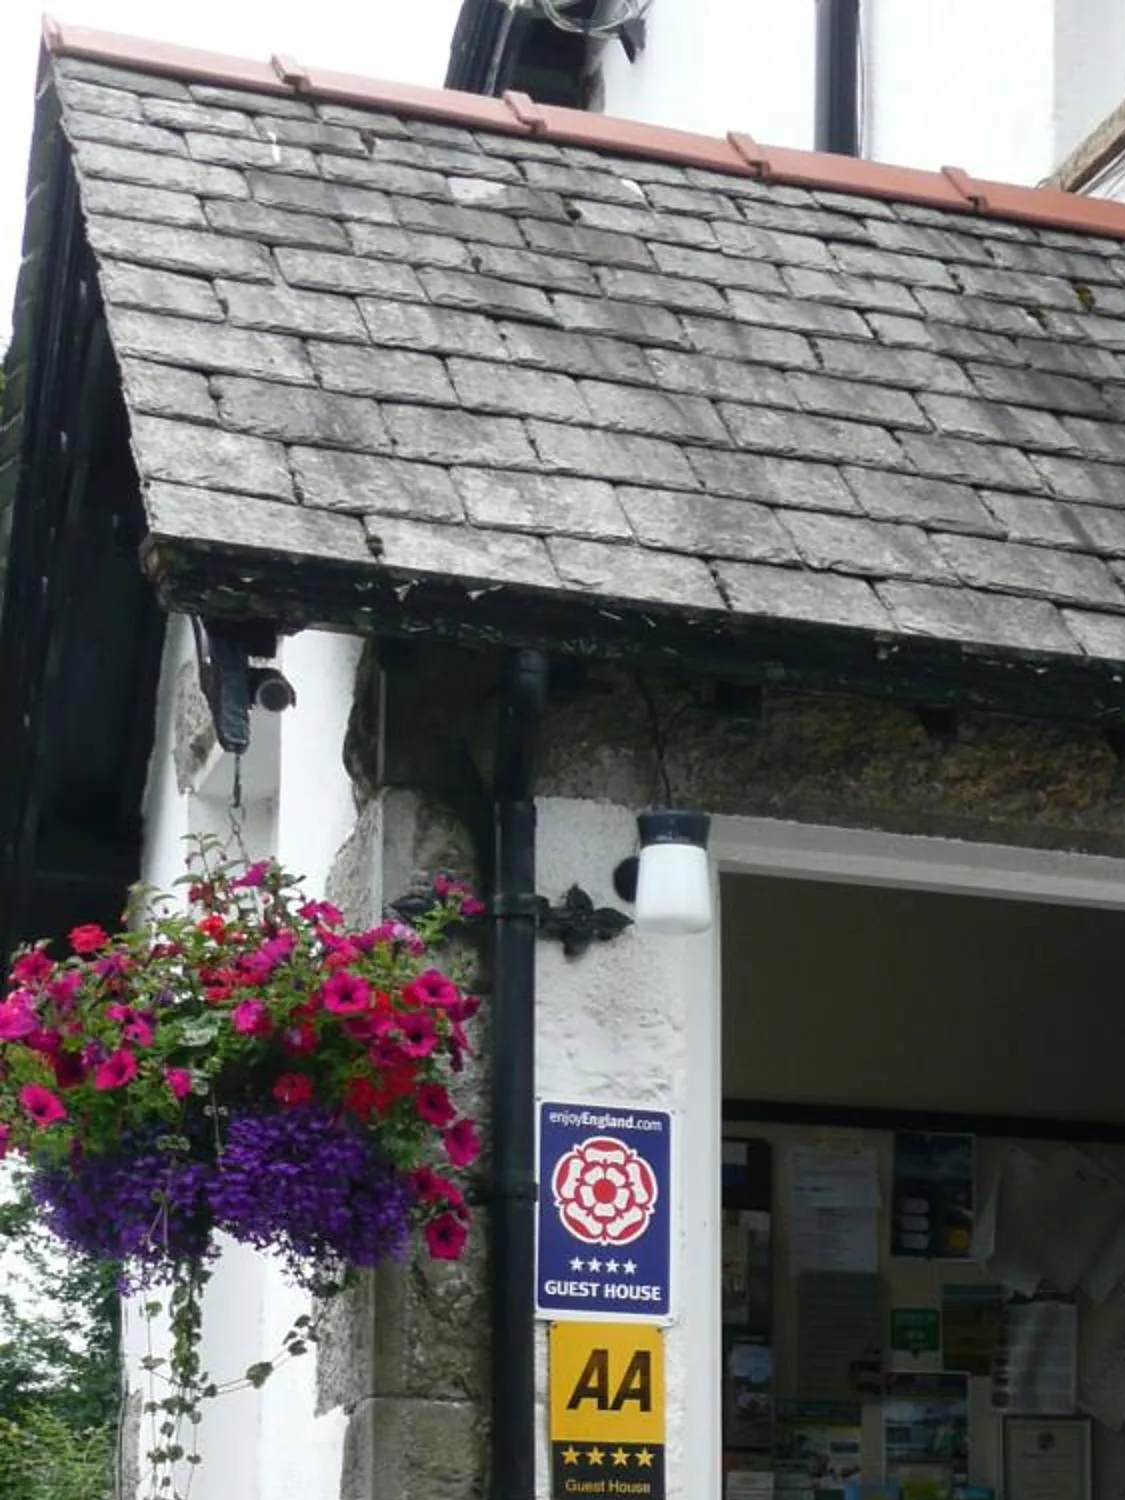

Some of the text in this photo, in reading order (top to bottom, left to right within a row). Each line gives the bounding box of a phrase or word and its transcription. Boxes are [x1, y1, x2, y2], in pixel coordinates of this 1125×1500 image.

[549, 1110, 663, 1131] enjoyEngland.com
[544, 1280, 662, 1301] GUEST HOUSE
[565, 1348, 652, 1412] AA
[565, 1478, 651, 1494] Guest House
